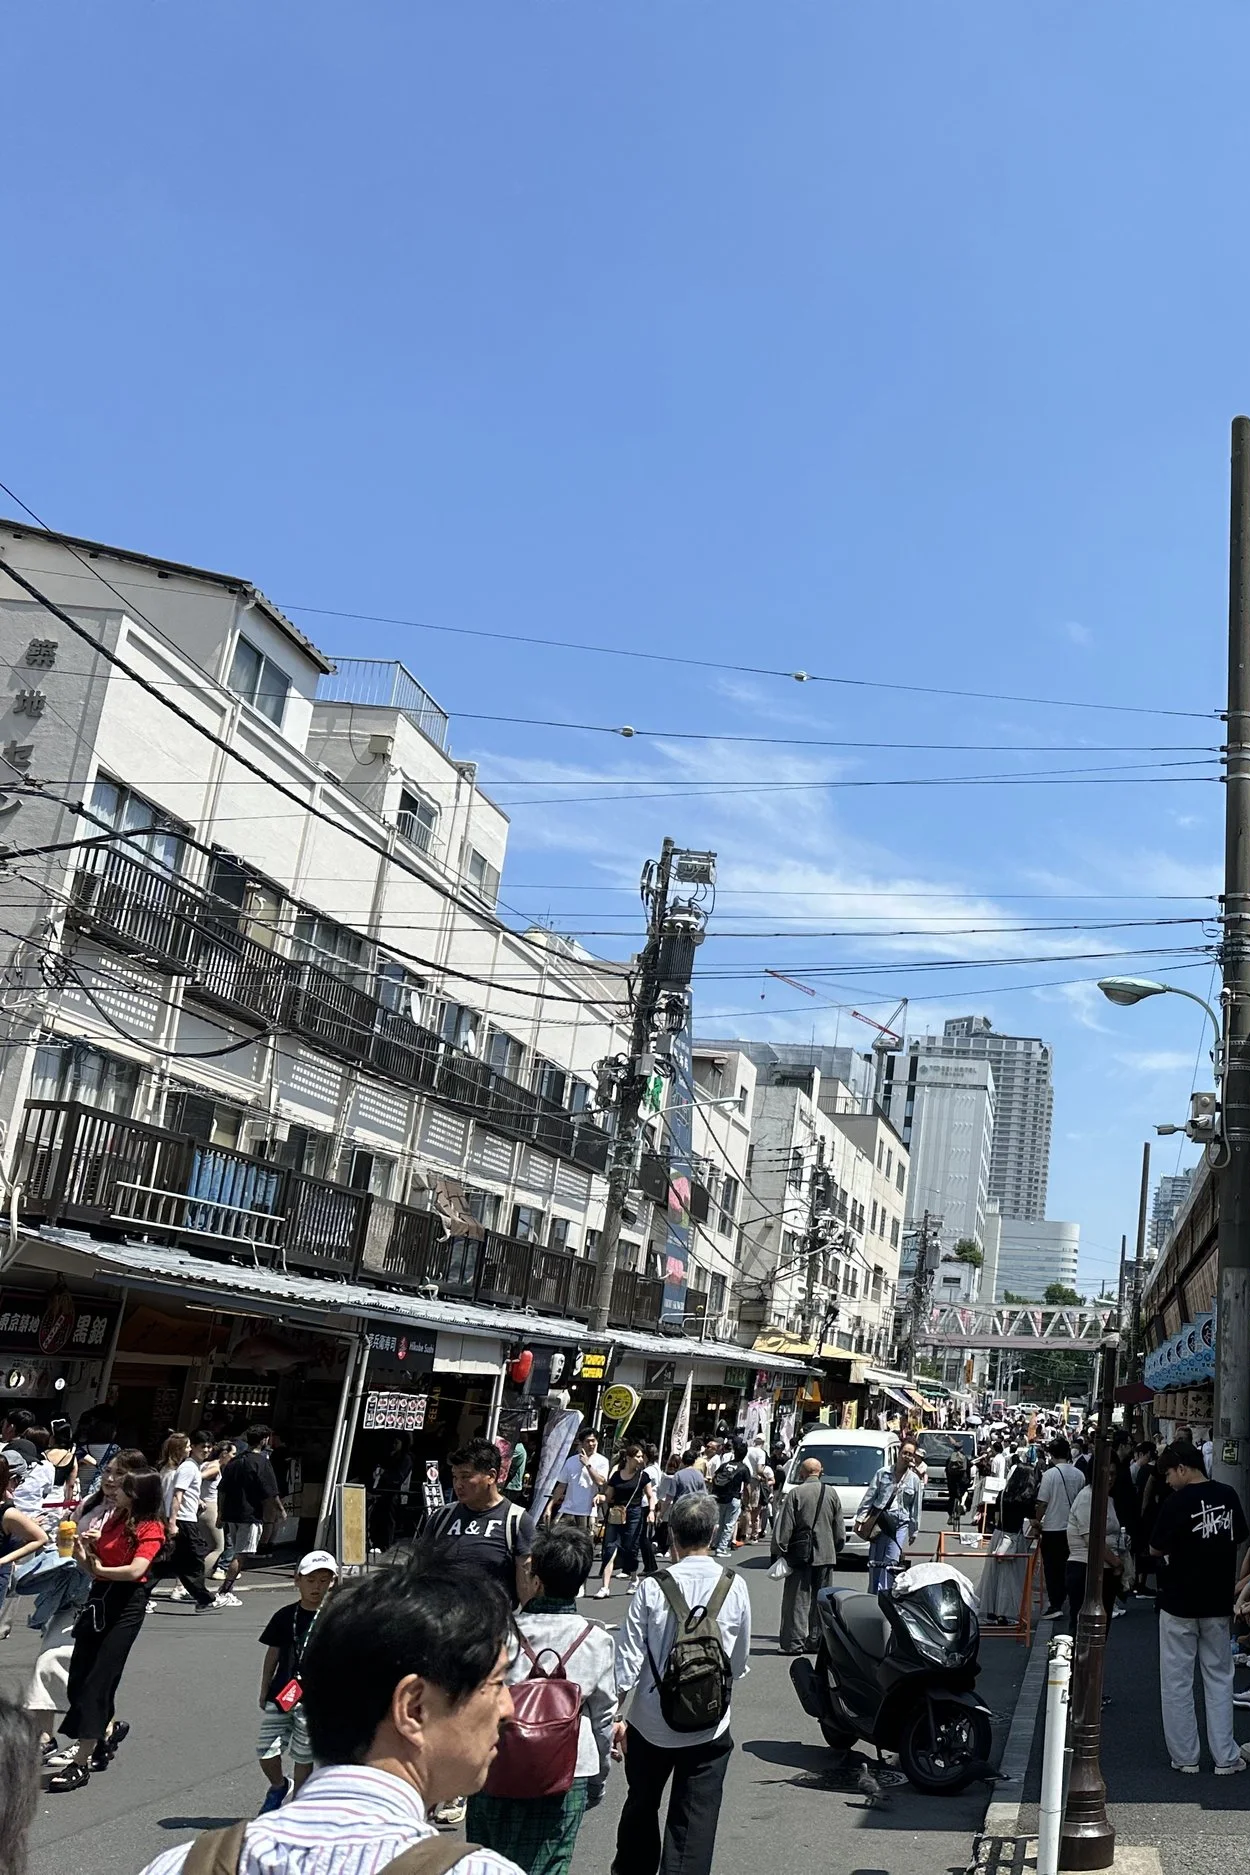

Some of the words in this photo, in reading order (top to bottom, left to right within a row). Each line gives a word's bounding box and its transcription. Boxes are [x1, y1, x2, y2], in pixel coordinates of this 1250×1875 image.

[447, 1519, 461, 1535] A
[465, 1520, 480, 1535] &
[484, 1520, 502, 1537] F
